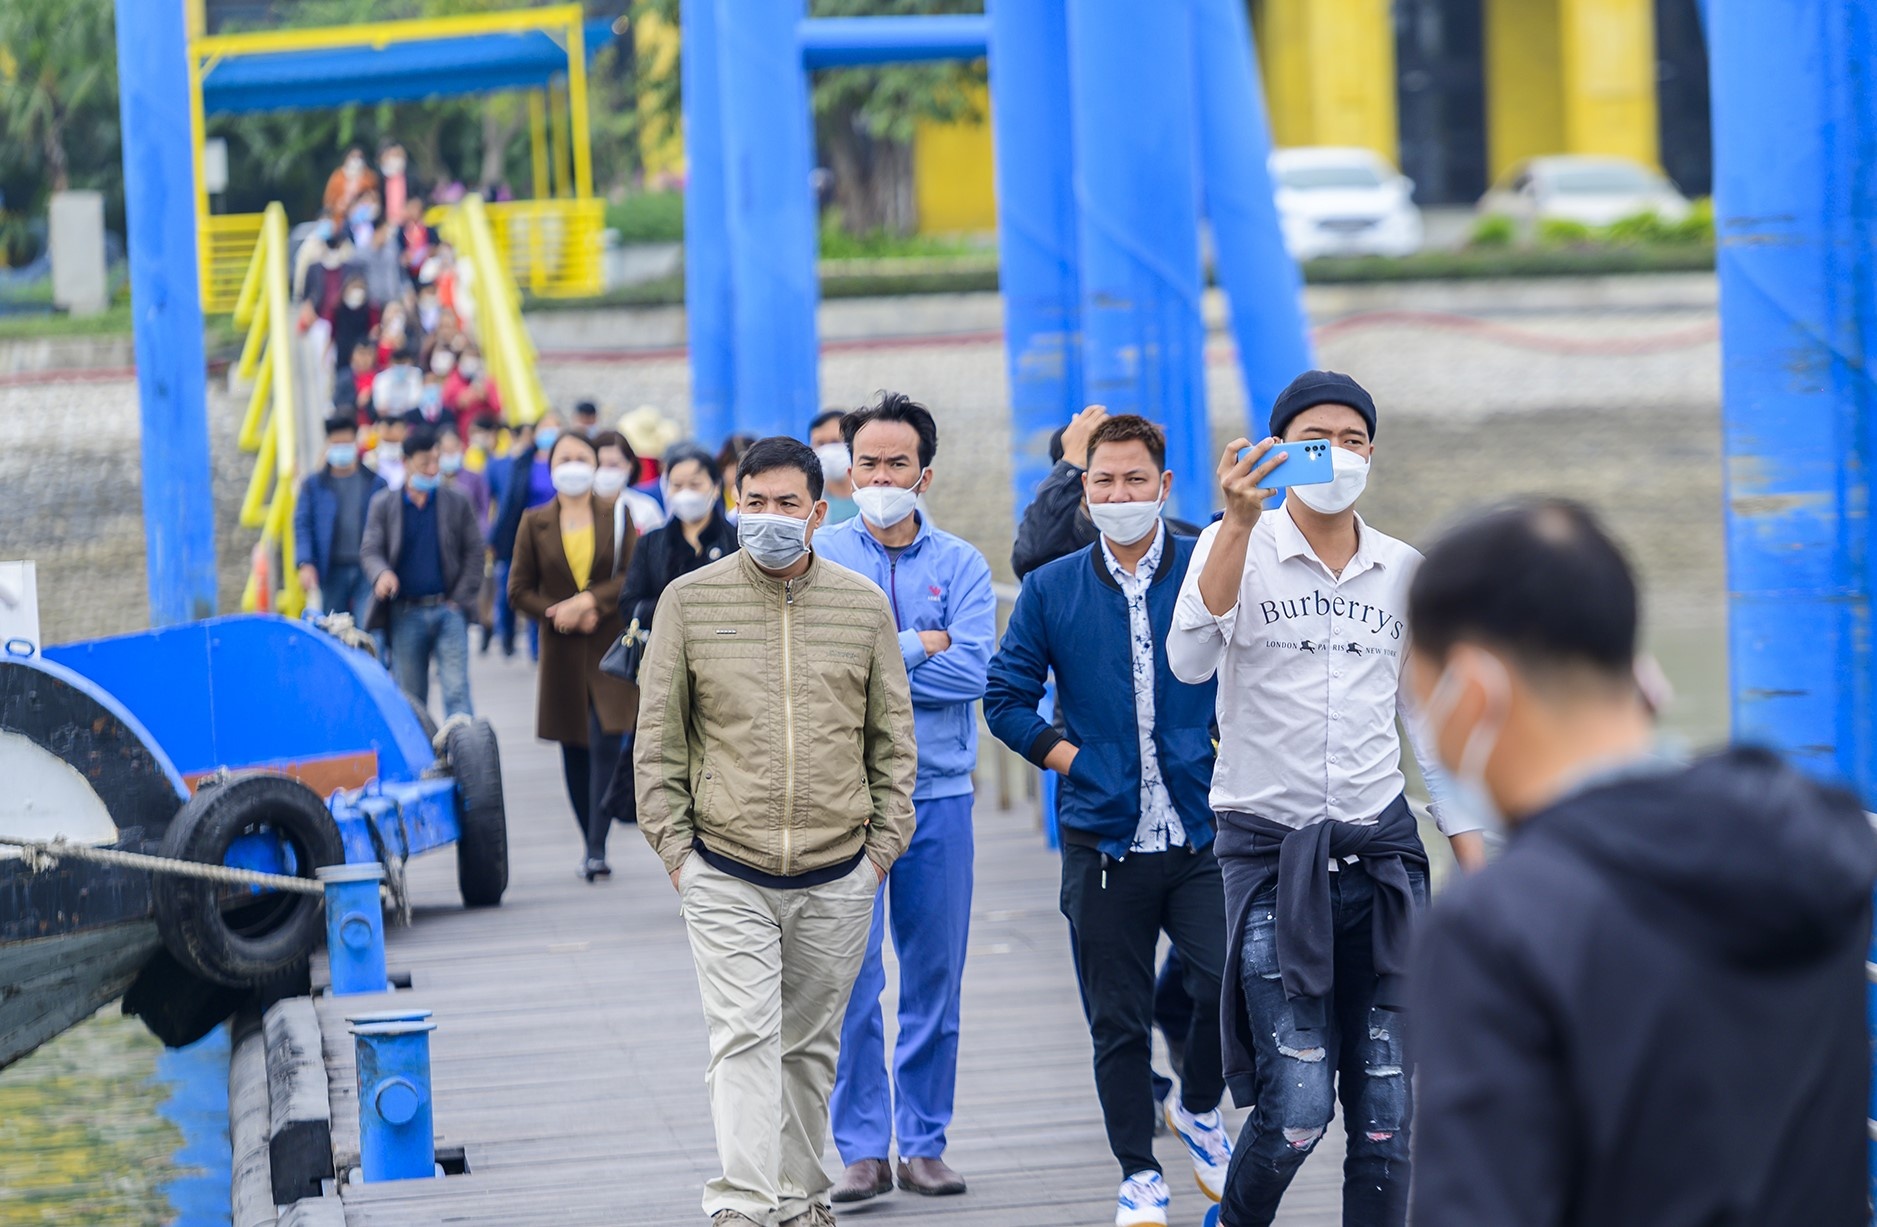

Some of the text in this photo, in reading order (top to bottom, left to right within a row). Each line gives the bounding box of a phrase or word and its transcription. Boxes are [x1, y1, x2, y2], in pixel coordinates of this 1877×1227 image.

[1259, 589, 1404, 640] Burberrys
[1266, 640, 1298, 650] LONDON
[1365, 647, 1381, 655] NEW
